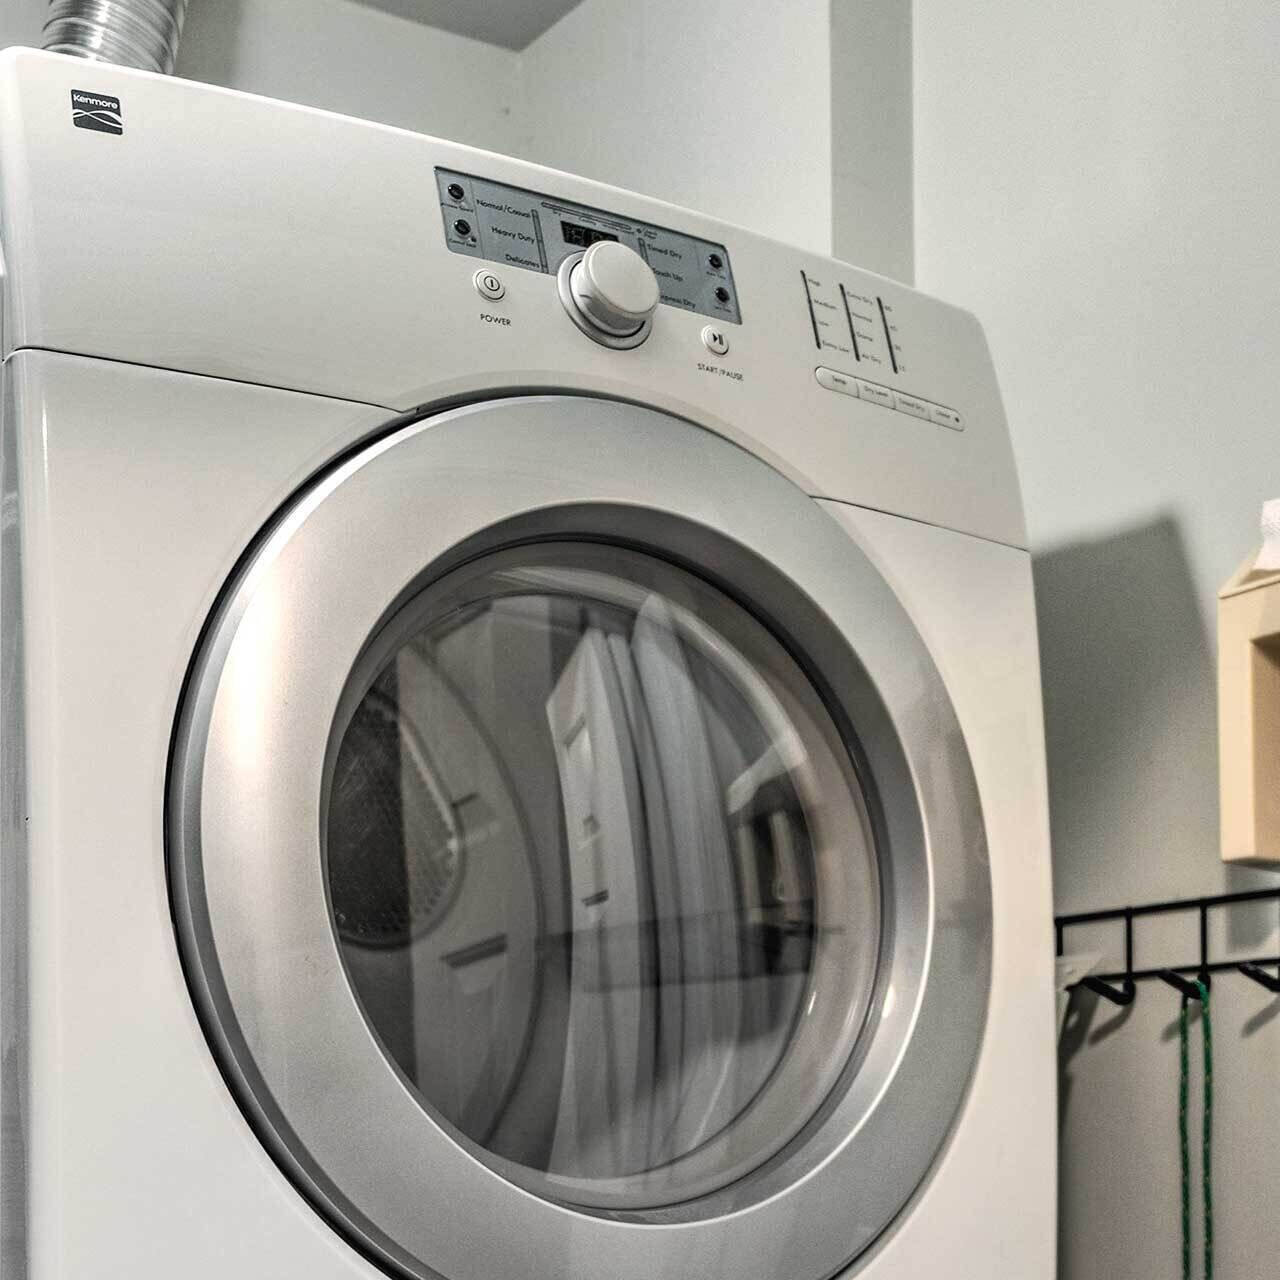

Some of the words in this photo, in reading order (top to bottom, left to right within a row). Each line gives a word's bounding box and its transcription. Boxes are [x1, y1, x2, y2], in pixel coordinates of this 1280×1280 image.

[73, 94, 118, 109] Kenmore
[491, 226, 516, 239] Heavy
[480, 312, 511, 326] POWER
